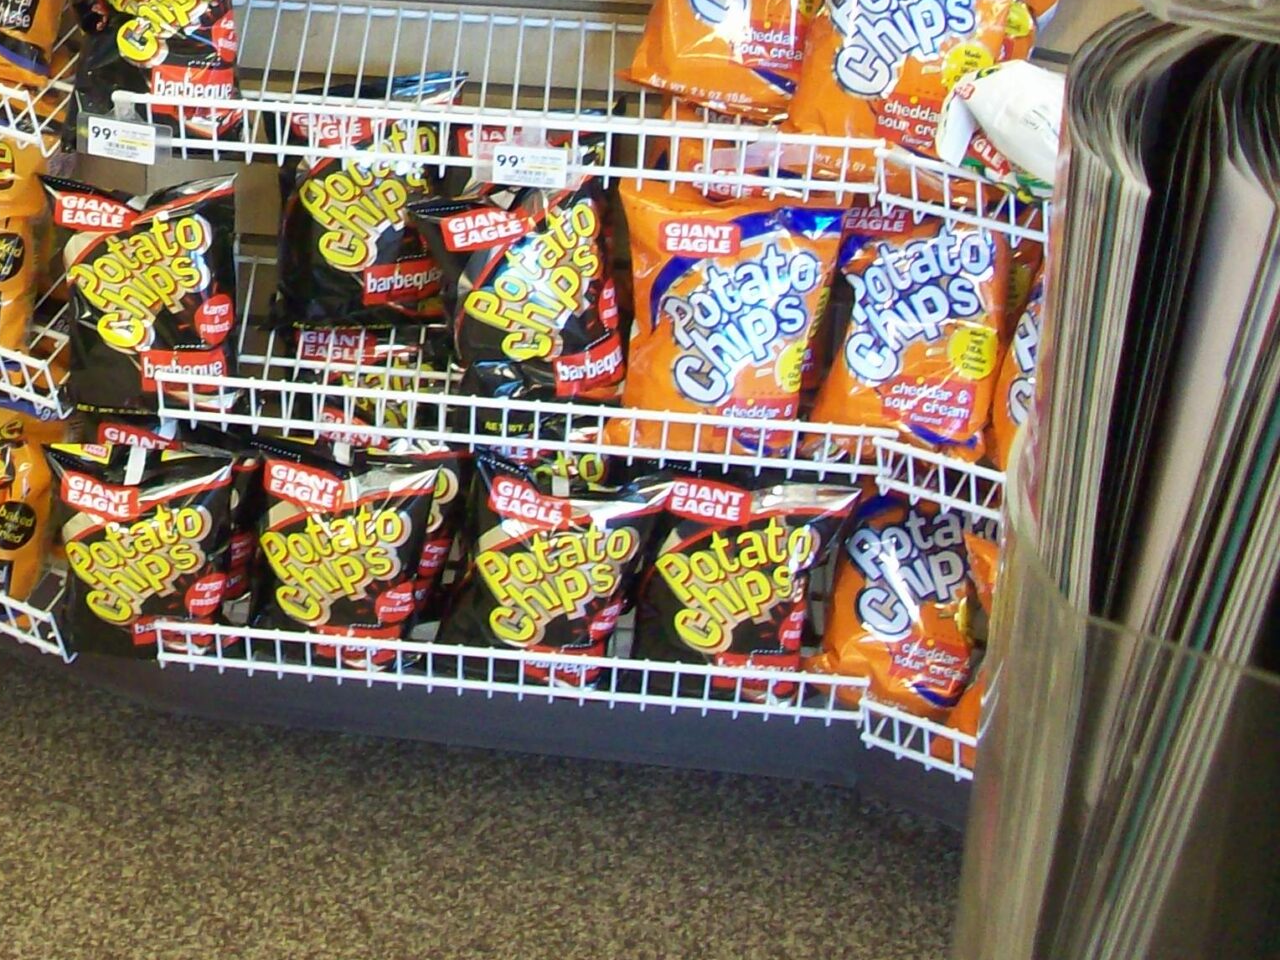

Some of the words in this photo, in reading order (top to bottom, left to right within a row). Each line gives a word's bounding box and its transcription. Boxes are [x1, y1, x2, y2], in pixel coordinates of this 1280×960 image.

[152, 72, 233, 98] barbeque
[877, 116, 910, 134] sour
[61, 196, 131, 216] GIANT
[62, 210, 125, 228] EAGLE
[847, 206, 908, 222] GIANT
[454, 217, 525, 249] EAGLE
[664, 223, 734, 241] GIANT
[844, 217, 905, 233] EAGLE
[665, 238, 732, 254] EAGLE
[70, 216, 203, 306] Potato
[464, 203, 597, 328] Potato
[97, 257, 201, 348] Chips
[501, 245, 599, 361] Chips
[663, 243, 819, 346] Potato
[845, 279, 979, 382] Chips
[674, 295, 806, 406] Chips
[890, 381, 952, 403] cheddar
[884, 396, 919, 411] sour
[921, 399, 970, 420] cream
[103, 426, 169, 450] GIANT
[68, 476, 131, 503] GIANT
[270, 464, 339, 492] GIANT
[67, 490, 130, 517] EAGLE
[269, 480, 333, 509] EAGLE
[671, 480, 745, 505] GIANT
[494, 496, 564, 524] EAGLE
[670, 496, 741, 522] EAGLE
[65, 504, 203, 587] Potato
[259, 504, 404, 580] Potato
[475, 523, 632, 600] Potato
[656, 519, 815, 598] Potato
[87, 542, 198, 622] Chips
[276, 547, 392, 622] Chips
[488, 558, 616, 643] Chips
[673, 564, 793, 650] Chips
